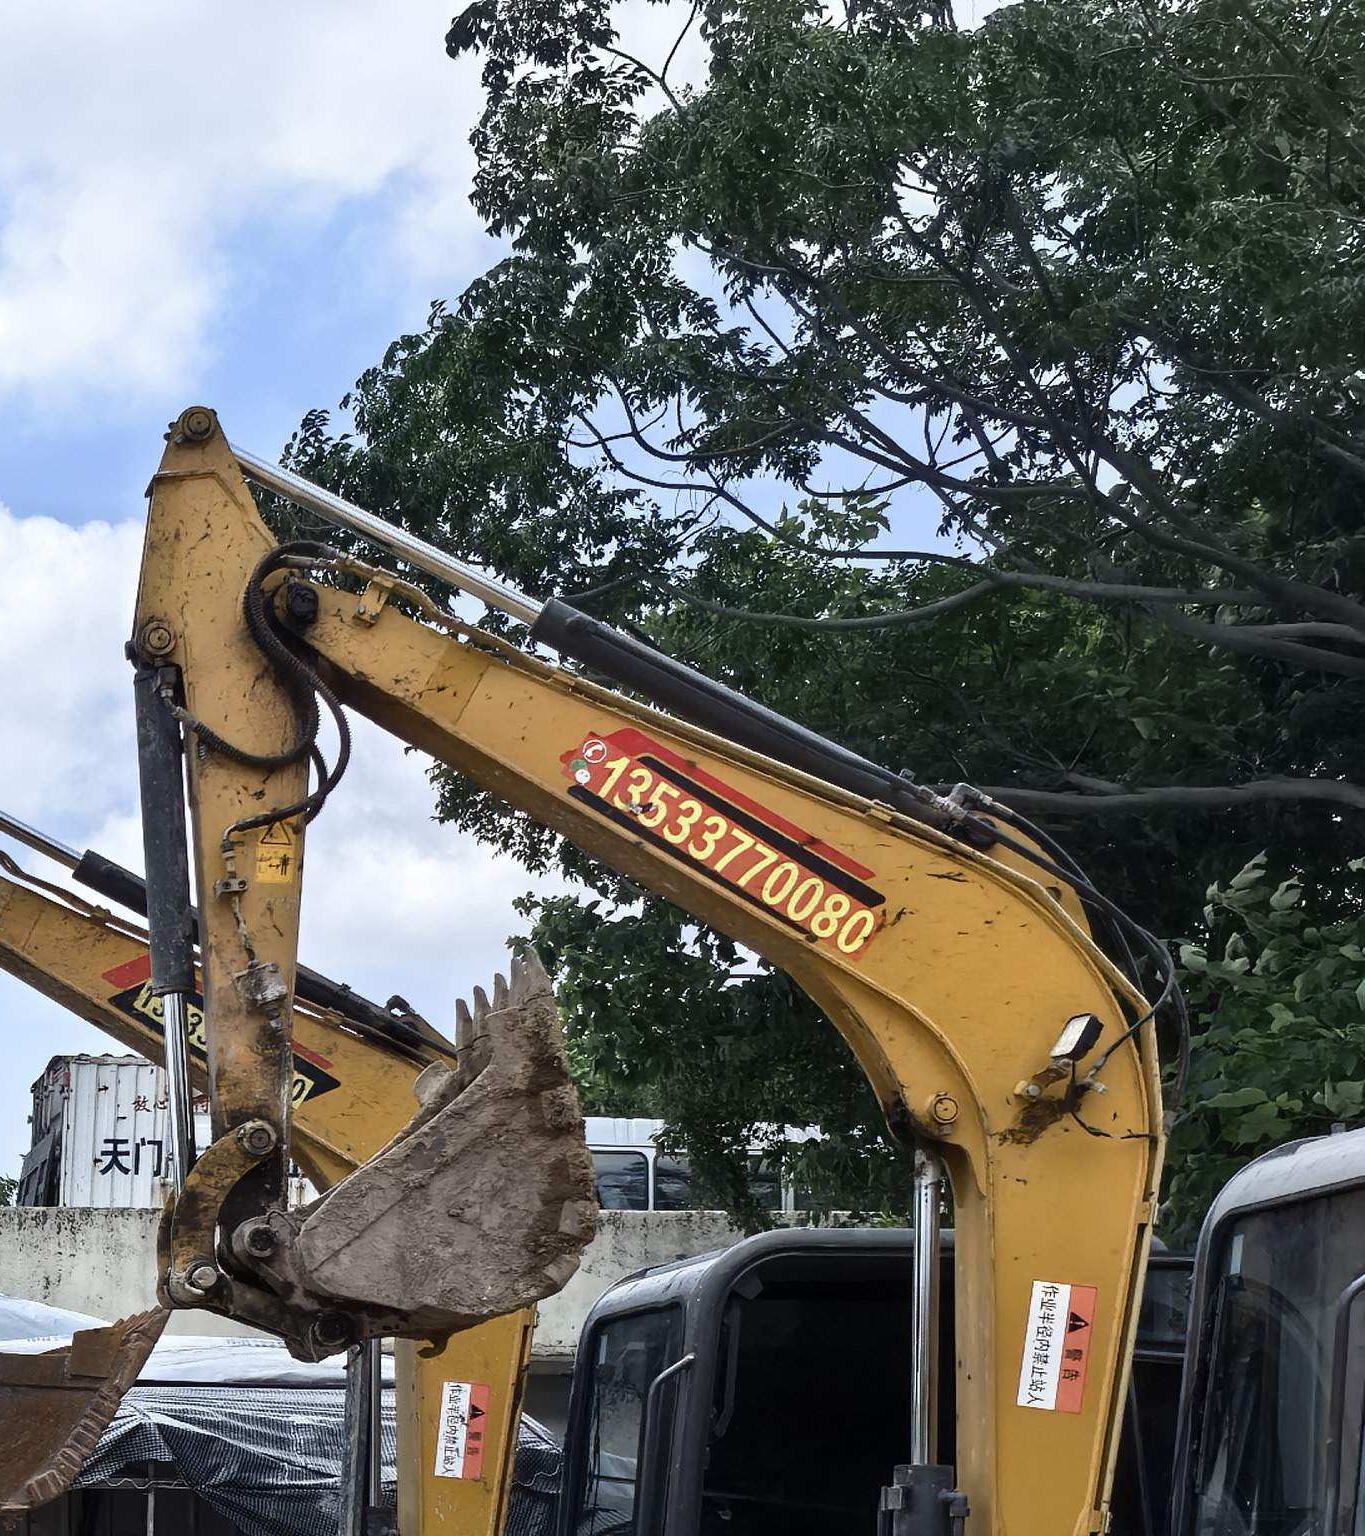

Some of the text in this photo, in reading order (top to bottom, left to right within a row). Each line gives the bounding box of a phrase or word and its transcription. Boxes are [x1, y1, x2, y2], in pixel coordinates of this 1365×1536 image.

[597, 757, 875, 954] 13533770080
[99, 1138, 163, 1178] 天门
[1027, 1285, 1059, 1405] 作业半径内禁止站人
